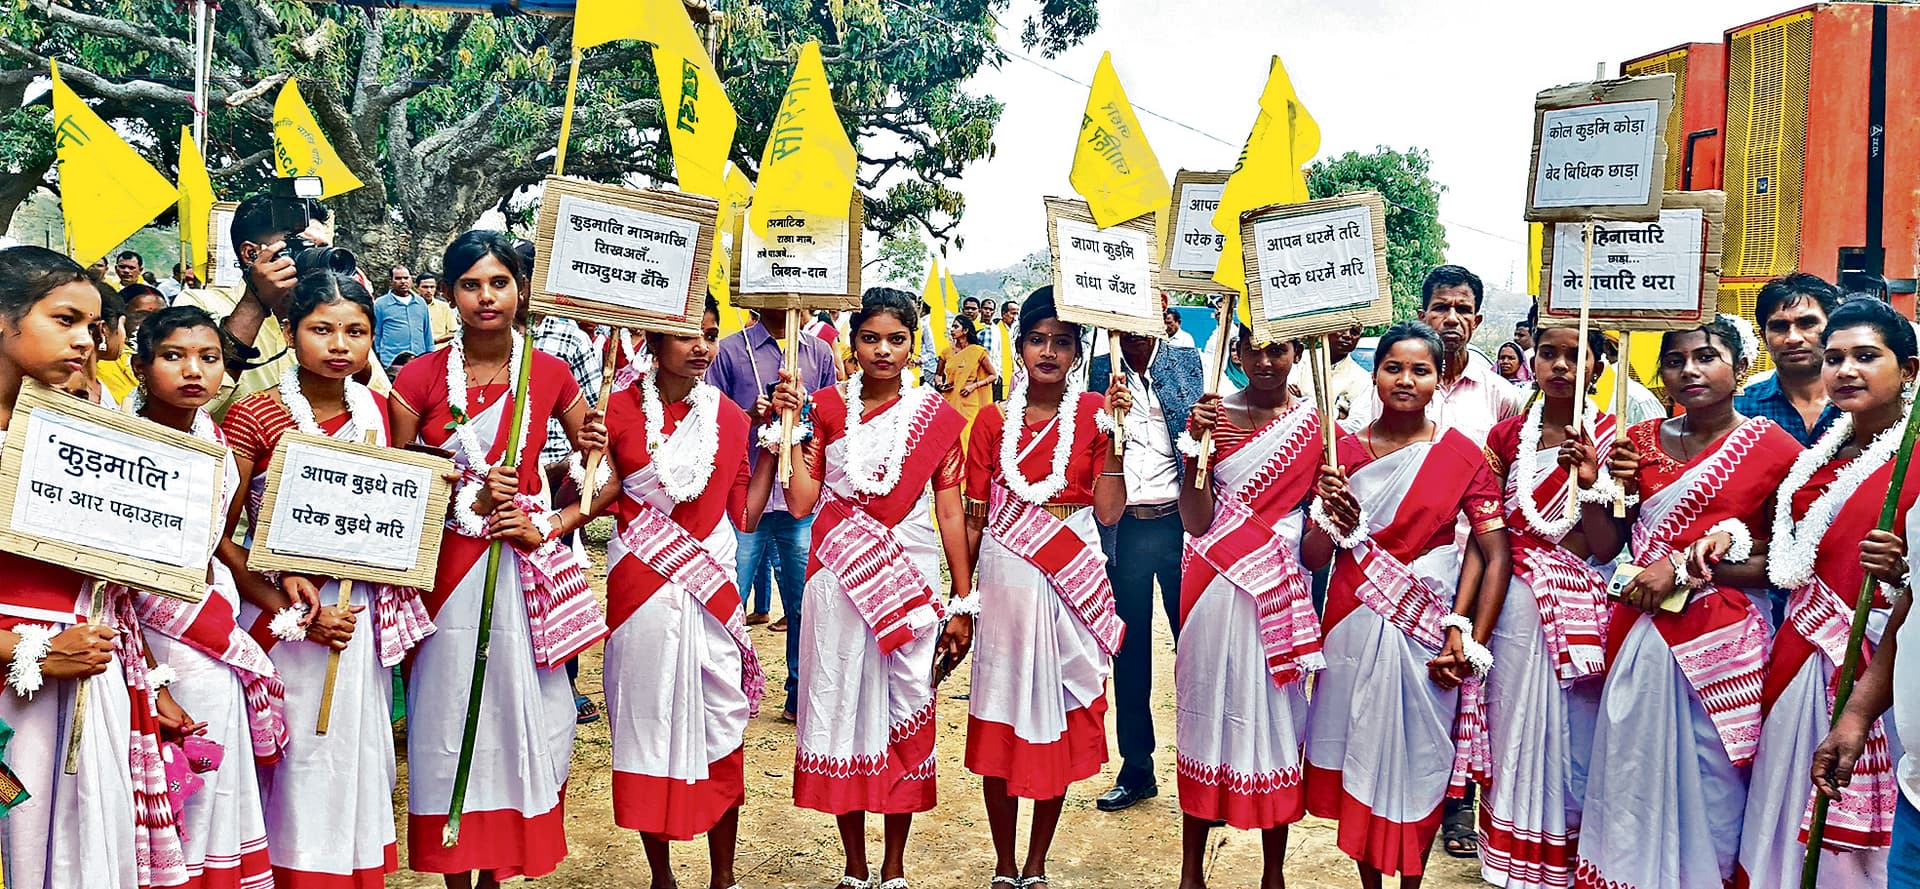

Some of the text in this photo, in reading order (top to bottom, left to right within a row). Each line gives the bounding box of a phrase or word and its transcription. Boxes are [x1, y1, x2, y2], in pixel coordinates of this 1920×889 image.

[1549, 115, 1645, 142] कोल कुड़मि कोड़ा
[1608, 164, 1639, 181] छाड़ा
[569, 214, 624, 236] कुड़मालि
[1184, 228, 1212, 246] परेक
[1267, 234, 1302, 251] आपन
[1339, 221, 1361, 240] तरि
[1071, 236, 1134, 261] जागा कुड़मि
[1271, 269, 1301, 289] परेक
[1340, 257, 1365, 277] मरि
[1642, 275, 1676, 290] धरा
[301, 465, 418, 499] आपन बुइधे तरि
[31, 480, 184, 531] पढ़ा आर पढ़ाउहान
[292, 504, 405, 539] परेक बुइधे मरि
